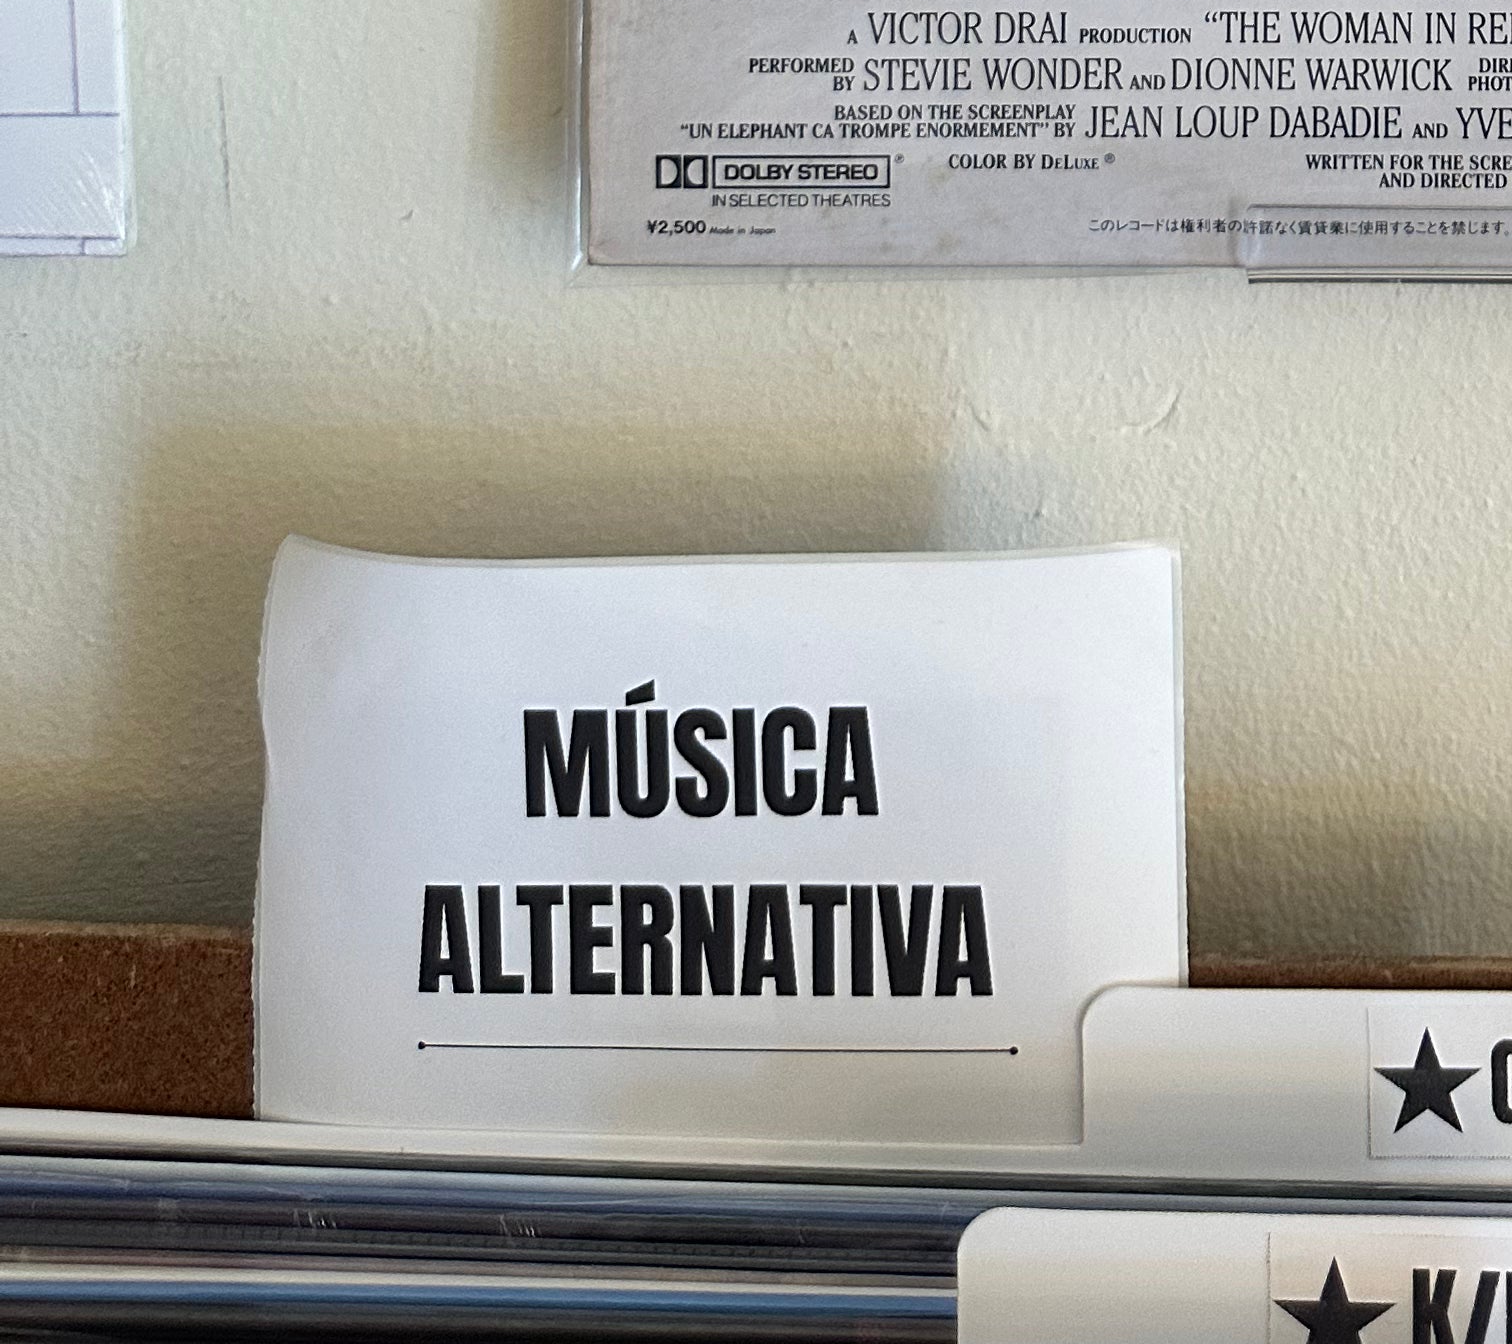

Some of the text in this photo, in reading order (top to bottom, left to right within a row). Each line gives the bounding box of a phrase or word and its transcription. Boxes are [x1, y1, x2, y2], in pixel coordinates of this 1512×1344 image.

[847, 30, 858, 44] A
[868, 12, 982, 44] VICTOR
[995, 12, 1067, 44] DRAI
[1080, 28, 1191, 43] PRODUCTION
[1205, 12, 1280, 43] "THE
[1291, 11, 1412, 44] WOMAN
[1426, 12, 1456, 44] IN
[834, 104, 1075, 120] BASED ON THE SCREENPLAY
[681, 122, 1075, 139] "UN ELEPHANT CA TROMPE ENORMEMENT" BY
[948, 154, 1007, 169] COLOR
[1014, 154, 1035, 169] BY
[1306, 154, 1383, 170] WRITTEN
[1390, 155, 1423, 170] FOR
[1429, 155, 1464, 170] THE
[724, 164, 879, 180] DOLBY STEREO
[1379, 173, 1415, 188] AND
[1421, 173, 1507, 188] DIRECTED
[712, 194, 890, 207] IN SELECTED THEATRES
[648, 220, 706, 236] ¥2,500
[523, 679, 881, 818] MÚSICA
[418, 884, 993, 998] ALTERNATIVA
